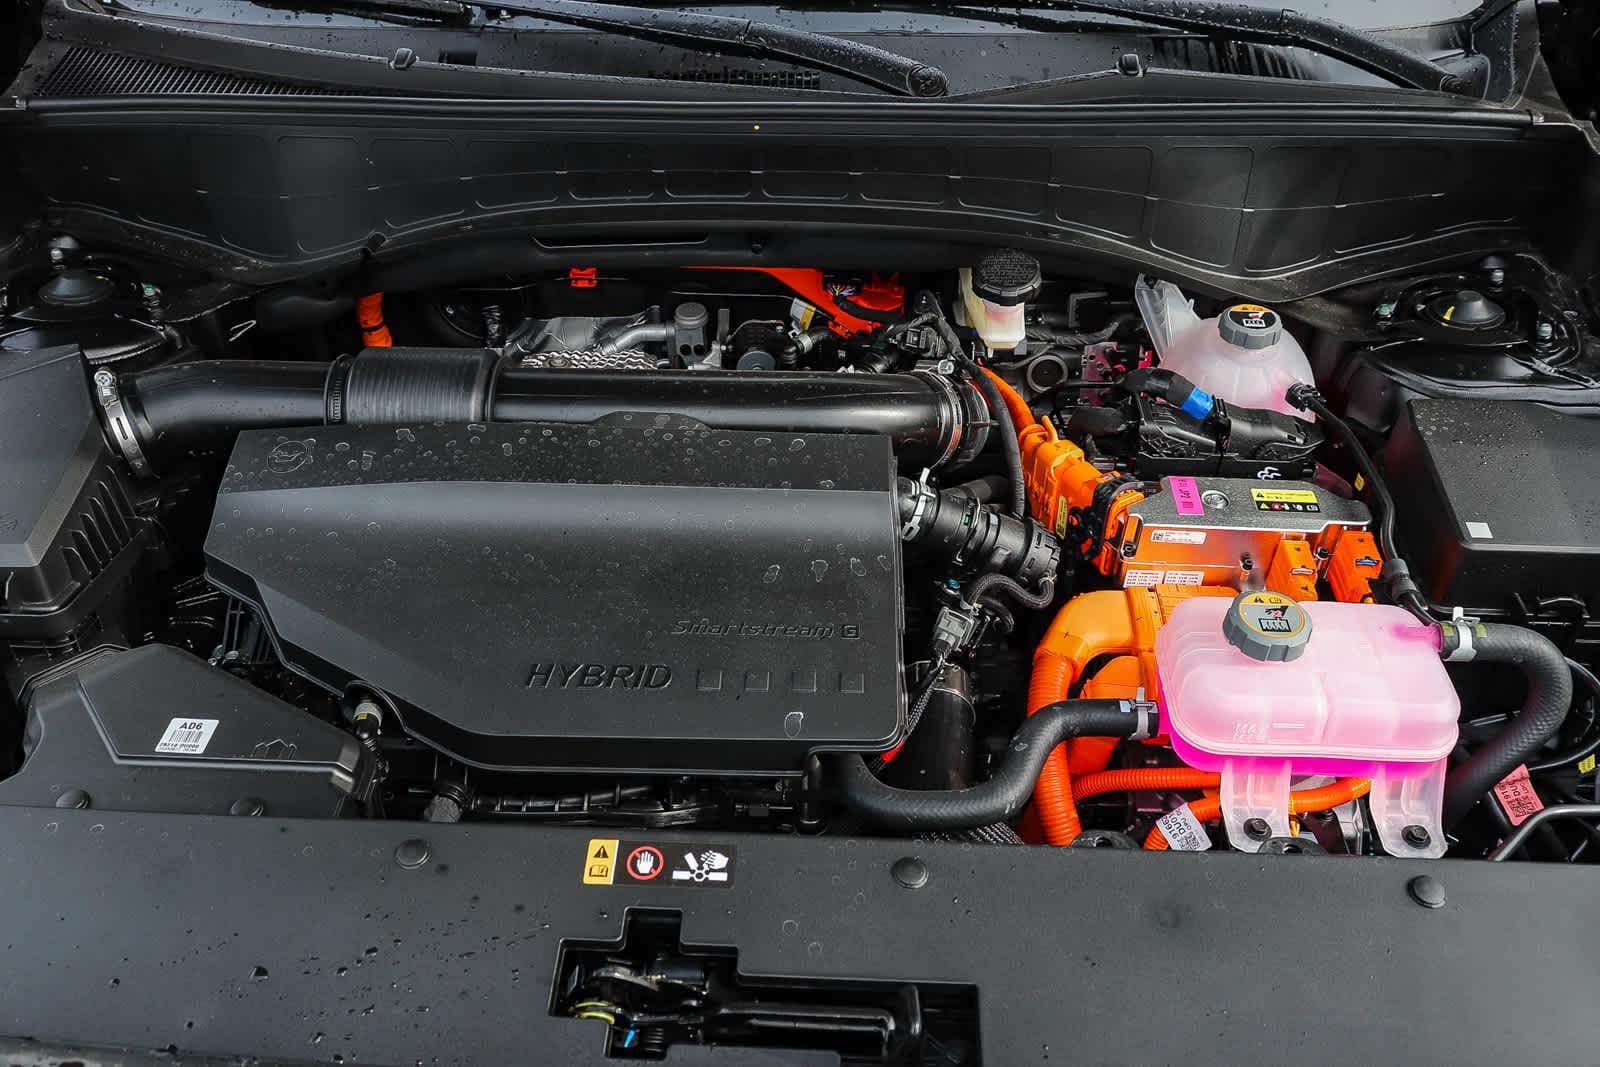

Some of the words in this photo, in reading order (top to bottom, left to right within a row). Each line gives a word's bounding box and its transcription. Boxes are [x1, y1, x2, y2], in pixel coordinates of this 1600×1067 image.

[671, 619, 833, 640] Smartstream
[840, 624, 861, 640] G
[526, 663, 673, 690] HYBRID
[178, 721, 204, 730] AD6
